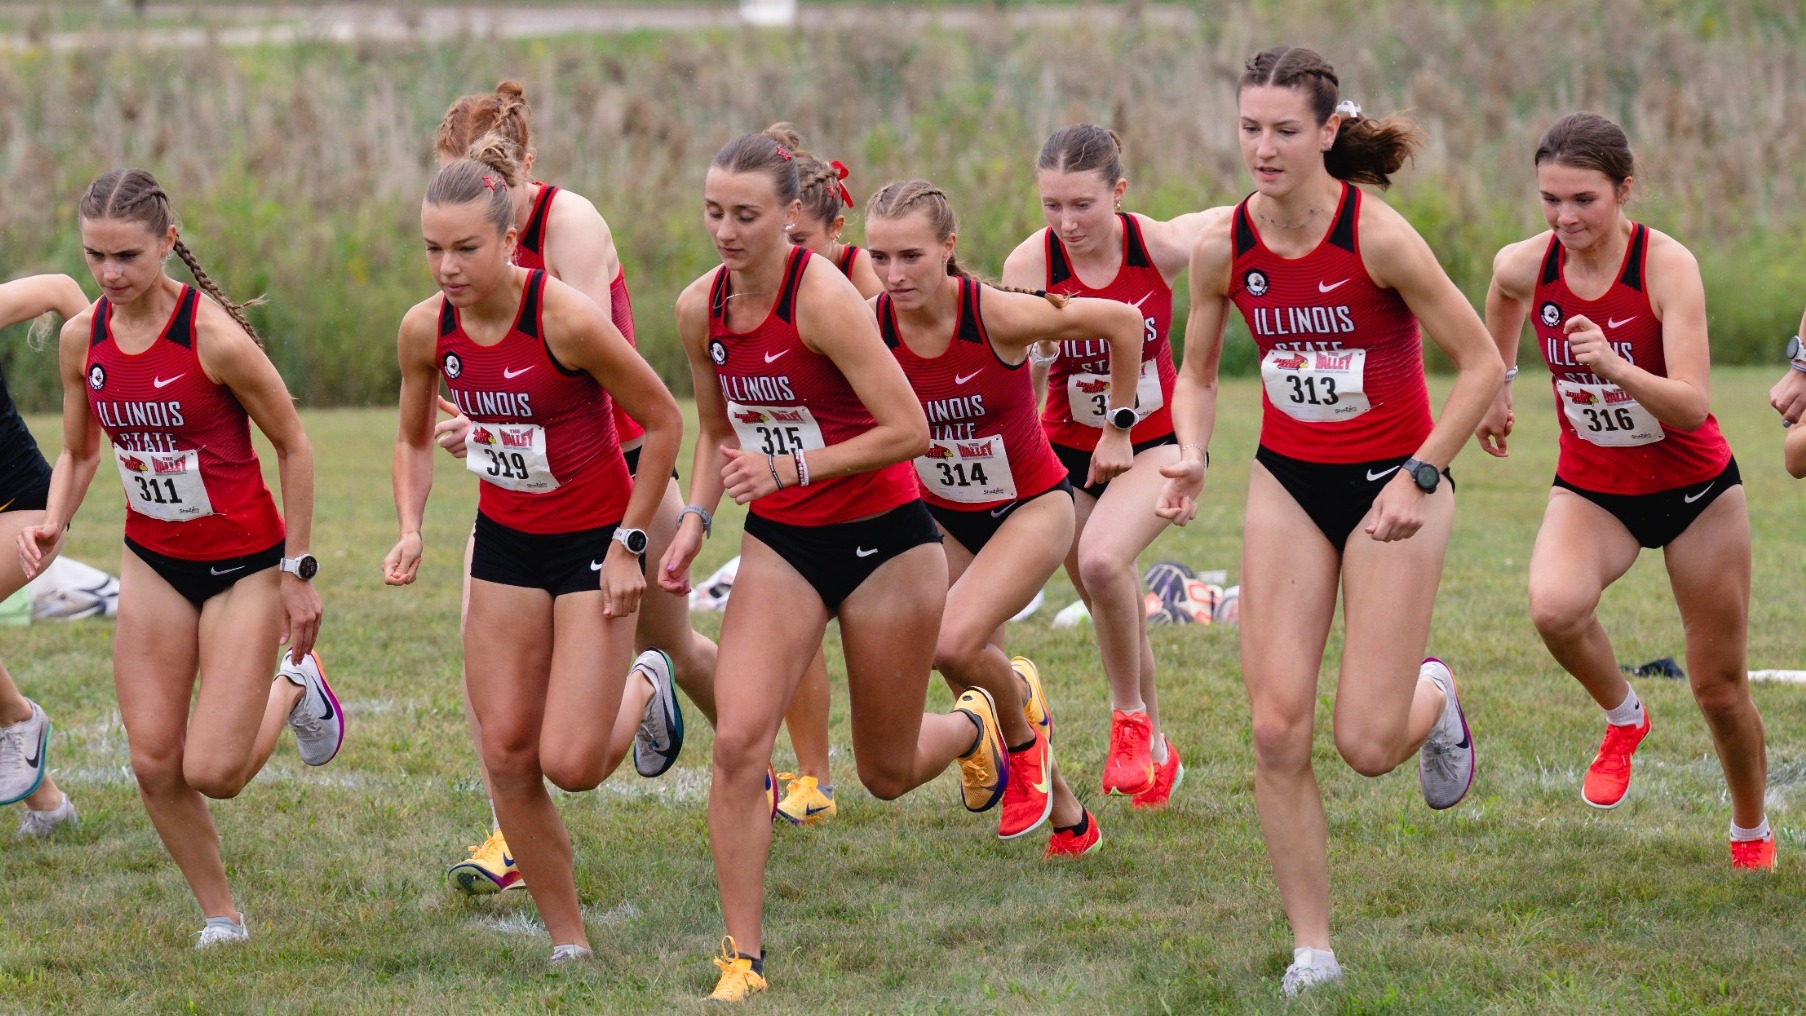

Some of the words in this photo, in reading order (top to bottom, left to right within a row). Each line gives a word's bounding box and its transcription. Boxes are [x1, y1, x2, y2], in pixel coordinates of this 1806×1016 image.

[1254, 306, 1355, 335] ILLINOIS
[1064, 317, 1157, 358] ILLIS
[1315, 351, 1353, 370] VALLEY
[720, 373, 796, 401] ILLINOIS
[1286, 375, 1339, 406] 313
[1601, 388, 1634, 402] VALLE
[97, 401, 185, 427] ILLINOIS
[450, 388, 533, 417] ILLINOIS
[927, 394, 986, 423] INOIS
[931, 422, 976, 440] TATE
[1583, 407, 1635, 432] 316
[499, 427, 534, 447] VALLEY
[756, 426, 804, 456] 315
[956, 440, 993, 457] VALLEY
[151, 455, 187, 473] VALLEY
[484, 448, 529, 479] 319
[936, 462, 988, 487] 314
[134, 475, 183, 504] 311
